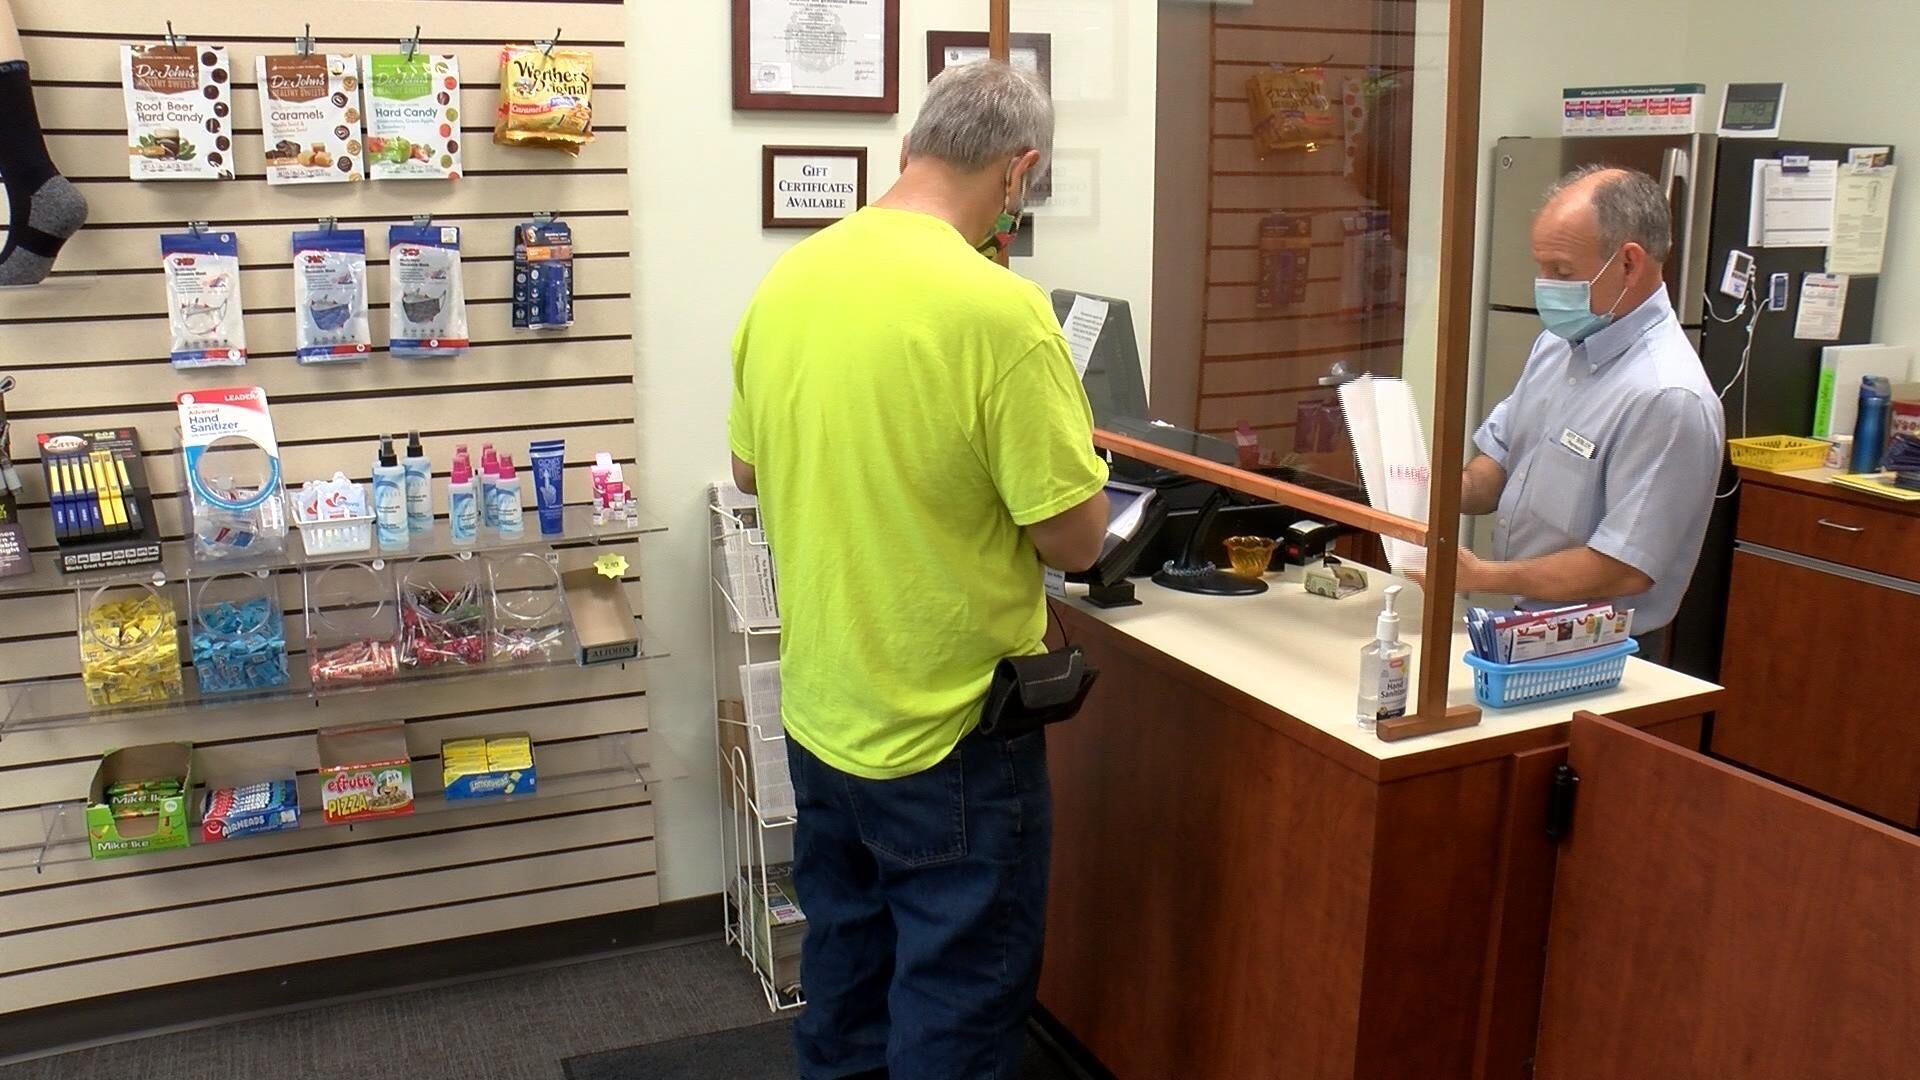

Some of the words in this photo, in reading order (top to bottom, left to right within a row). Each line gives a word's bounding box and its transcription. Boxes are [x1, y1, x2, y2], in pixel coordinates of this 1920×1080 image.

[136, 101, 162, 111] Root
[167, 102, 194, 111] Beer
[138, 112, 164, 121] Hard
[167, 112, 204, 123] Candy
[271, 109, 324, 120] Caramels
[376, 108, 401, 117] Hard
[404, 108, 438, 118] Candy
[802, 164, 828, 177] GIFT
[778, 180, 854, 193] CERTIFICATES
[786, 196, 846, 209] AVAILABLE
[224, 391, 258, 402] LEADER
[189, 414, 219, 424] Hand
[190, 422, 239, 433] Sanitizer
[327, 774, 374, 793] efrutti
[112, 794, 147, 804] Mike
[328, 794, 367, 818] PIZZA
[222, 816, 265, 838] AIRHEADS
[97, 841, 128, 850] Mike
[131, 840, 149, 848] Ike
